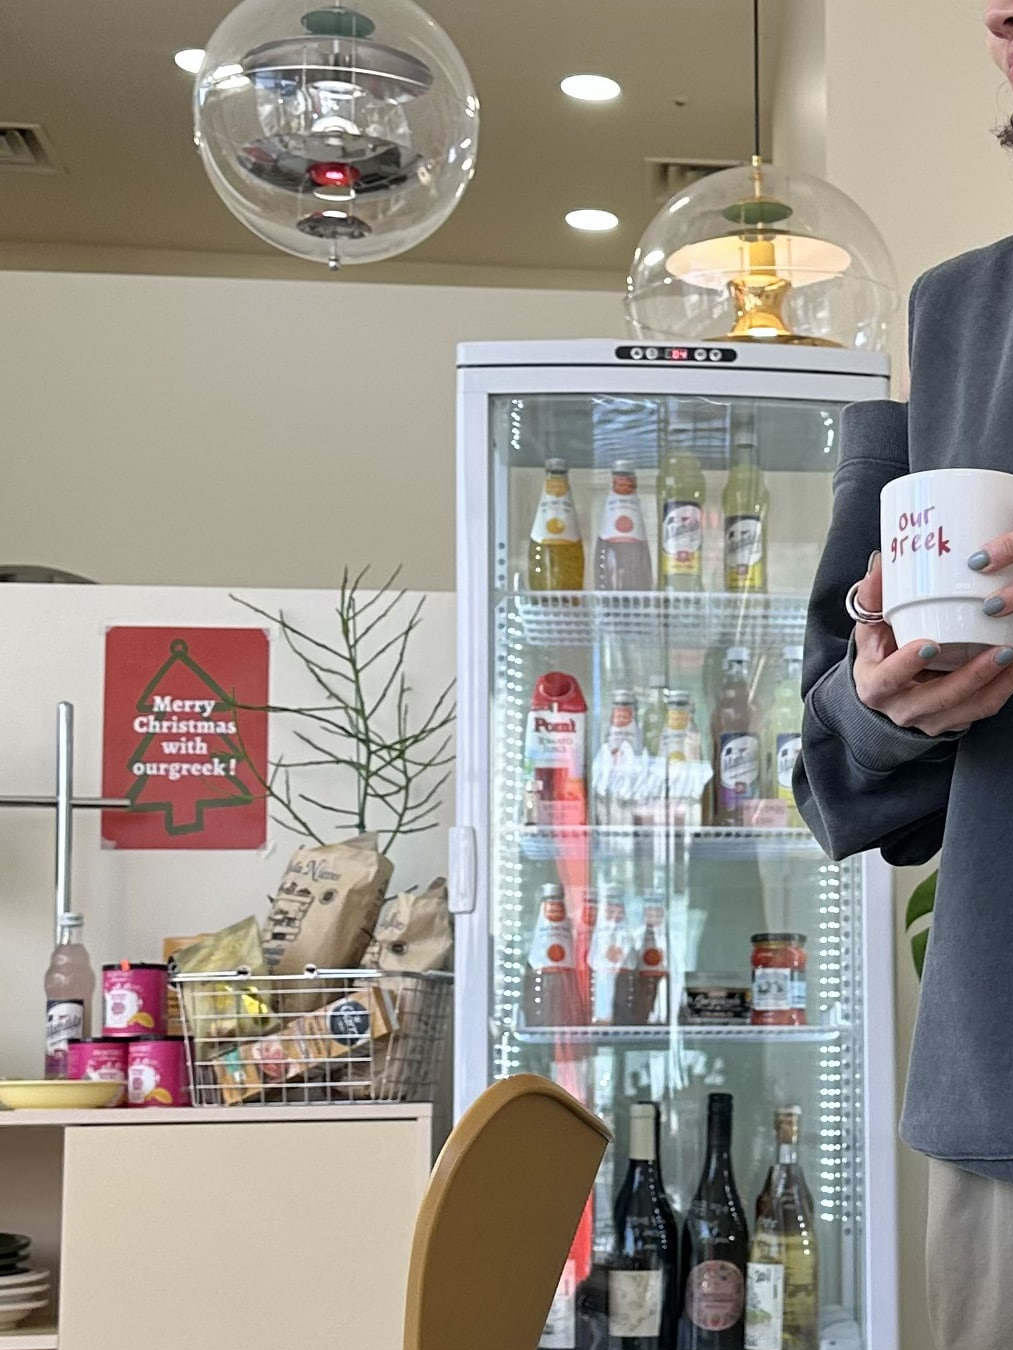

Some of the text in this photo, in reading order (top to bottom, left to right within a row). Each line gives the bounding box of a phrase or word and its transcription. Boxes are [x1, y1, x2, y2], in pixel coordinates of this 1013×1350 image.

[898, 505, 935, 532] our
[891, 525, 951, 564] greek
[152, 695, 216, 717] Merry
[133, 714, 237, 734] Christmas
[161, 736, 208, 755] with
